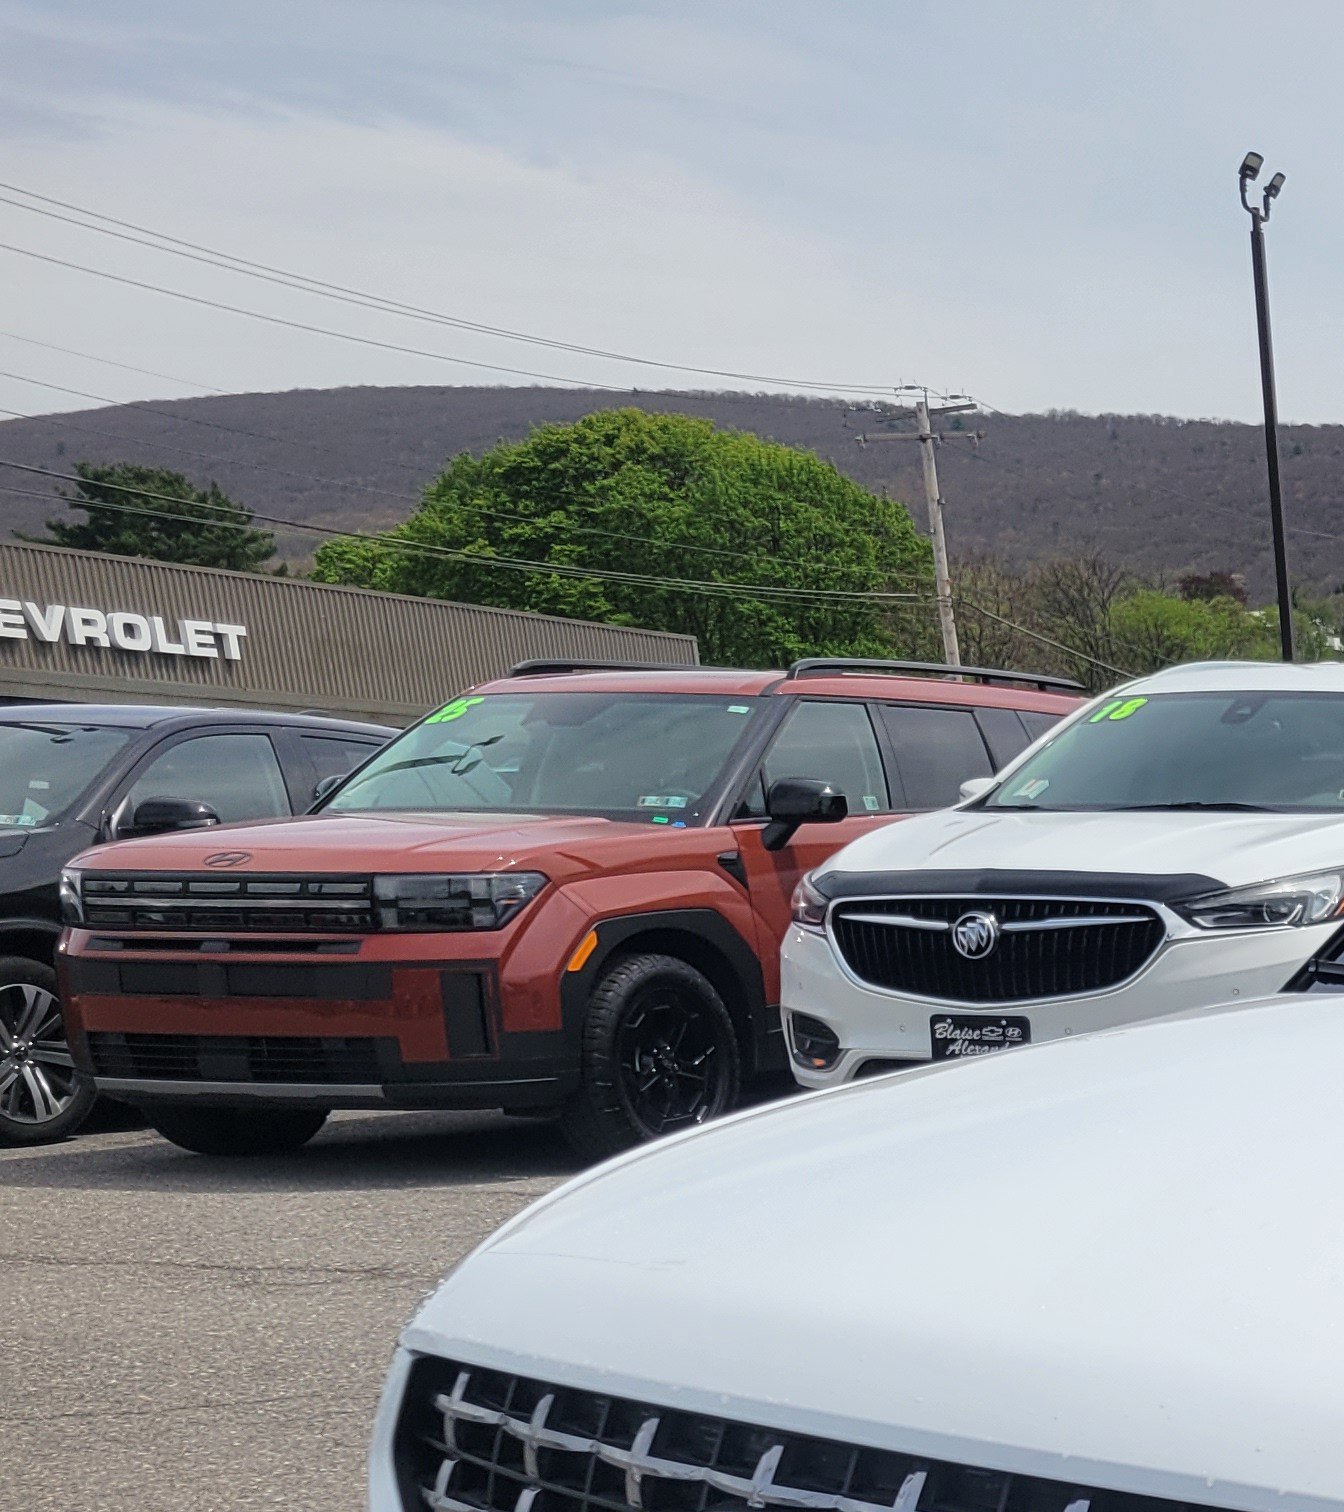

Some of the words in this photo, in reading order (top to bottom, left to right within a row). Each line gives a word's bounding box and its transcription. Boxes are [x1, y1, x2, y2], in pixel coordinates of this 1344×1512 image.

[0, 599, 247, 660] EVROLET
[1089, 698, 1148, 723] 18
[934, 1022, 981, 1040] Blaise
